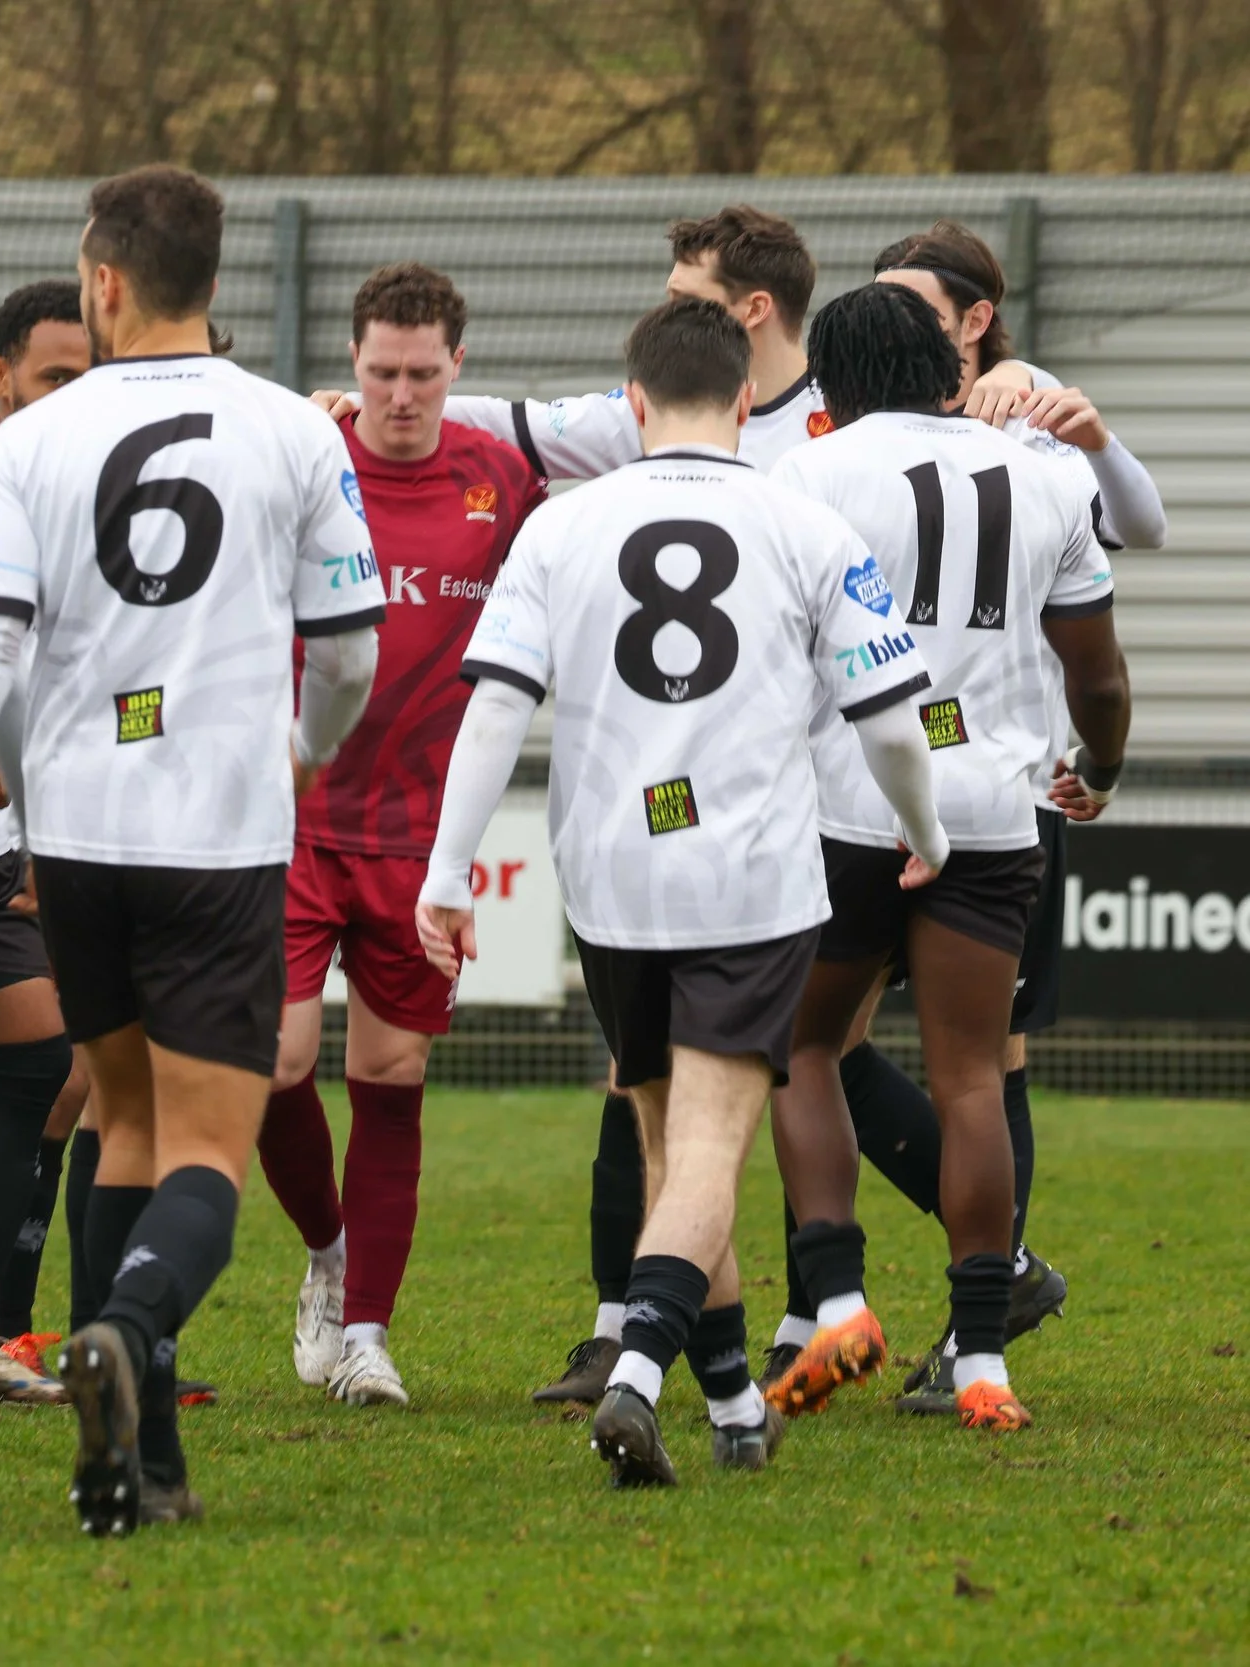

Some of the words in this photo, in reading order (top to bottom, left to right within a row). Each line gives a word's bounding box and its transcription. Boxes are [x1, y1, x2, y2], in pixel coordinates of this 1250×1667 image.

[94, 412, 224, 607] 6
[902, 460, 1012, 630] 11
[614, 519, 740, 705] 8
[127, 690, 161, 711] BIG
[929, 702, 958, 720] BIG
